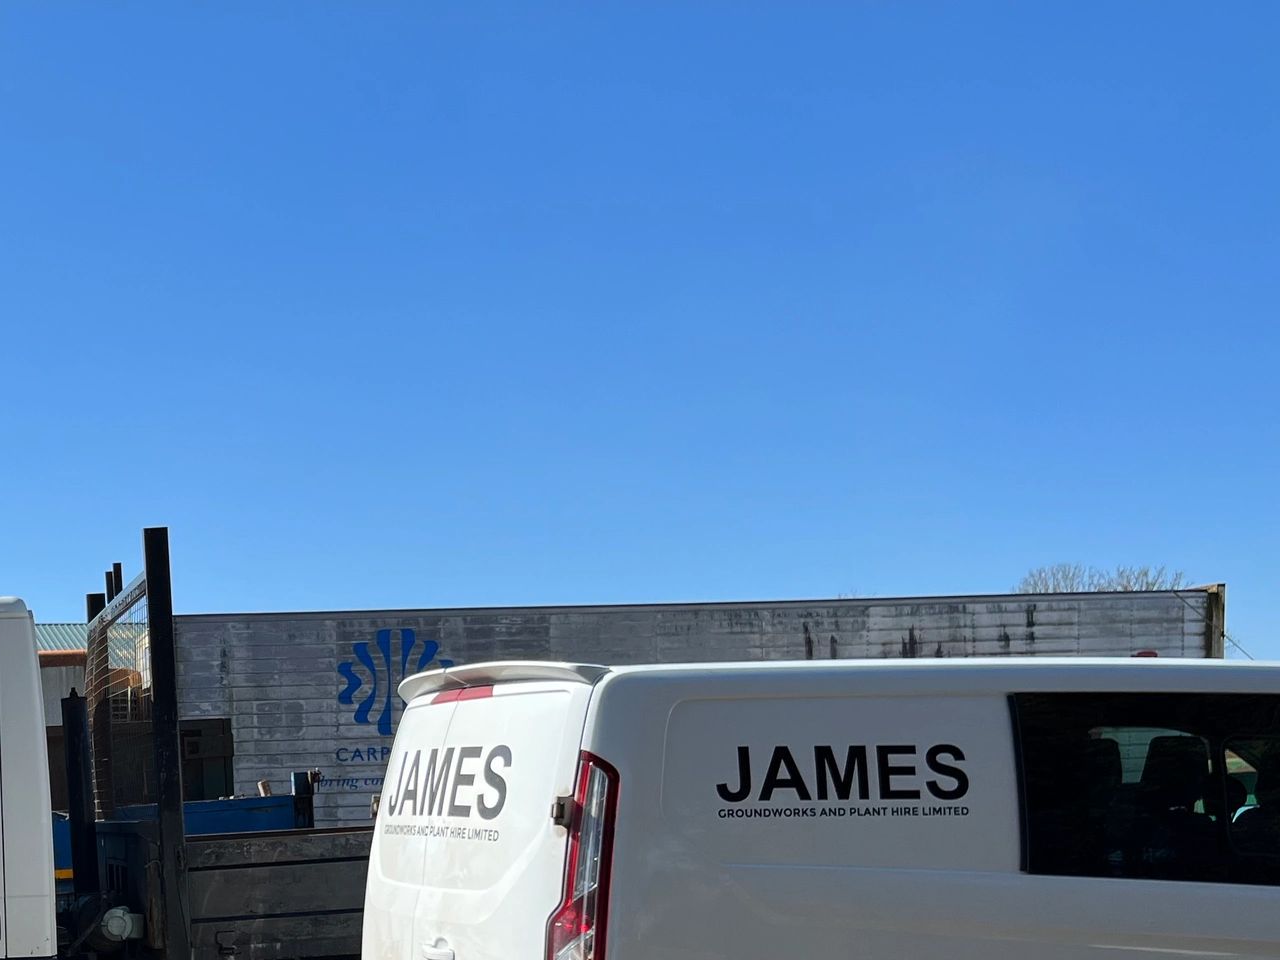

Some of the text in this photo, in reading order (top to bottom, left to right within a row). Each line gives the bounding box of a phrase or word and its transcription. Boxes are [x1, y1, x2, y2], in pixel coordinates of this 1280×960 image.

[335, 746, 390, 763] CARP
[388, 744, 513, 820] JAMES
[716, 743, 969, 803] JAMES
[718, 806, 969, 819] GROUNDWORKS AND PLANT HIRE LIMITED
[384, 824, 499, 842] GROUNDWORKS AND PLANT HIRE LIMITED
